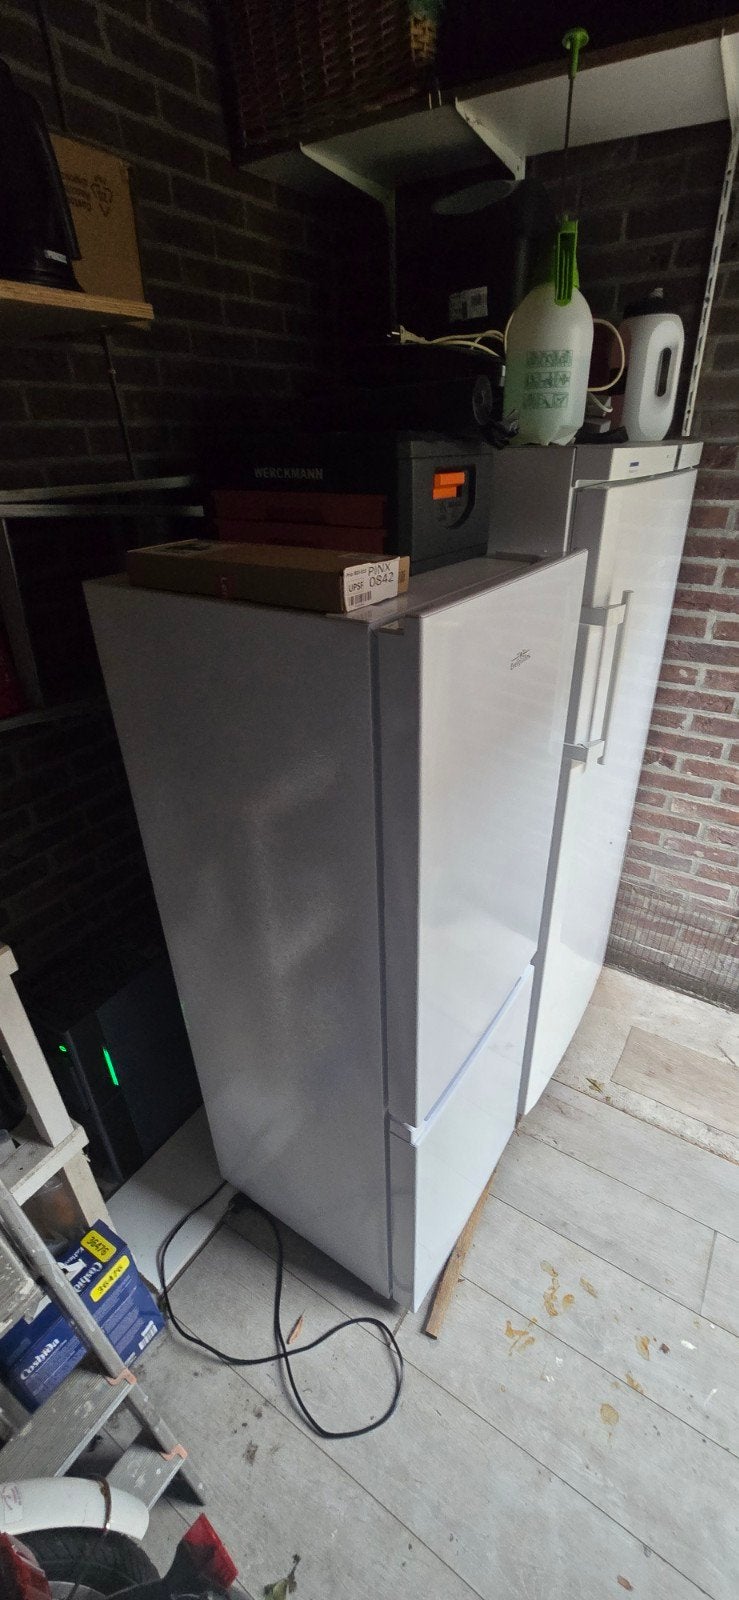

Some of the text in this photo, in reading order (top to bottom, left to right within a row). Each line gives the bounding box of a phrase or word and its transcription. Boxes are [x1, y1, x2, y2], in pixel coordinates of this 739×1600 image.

[254, 466, 324, 481] WERCKMANN
[369, 571, 394, 587] 0842
[73, 1262, 103, 1293] Coshid
[21, 1338, 60, 1380] Coshida
